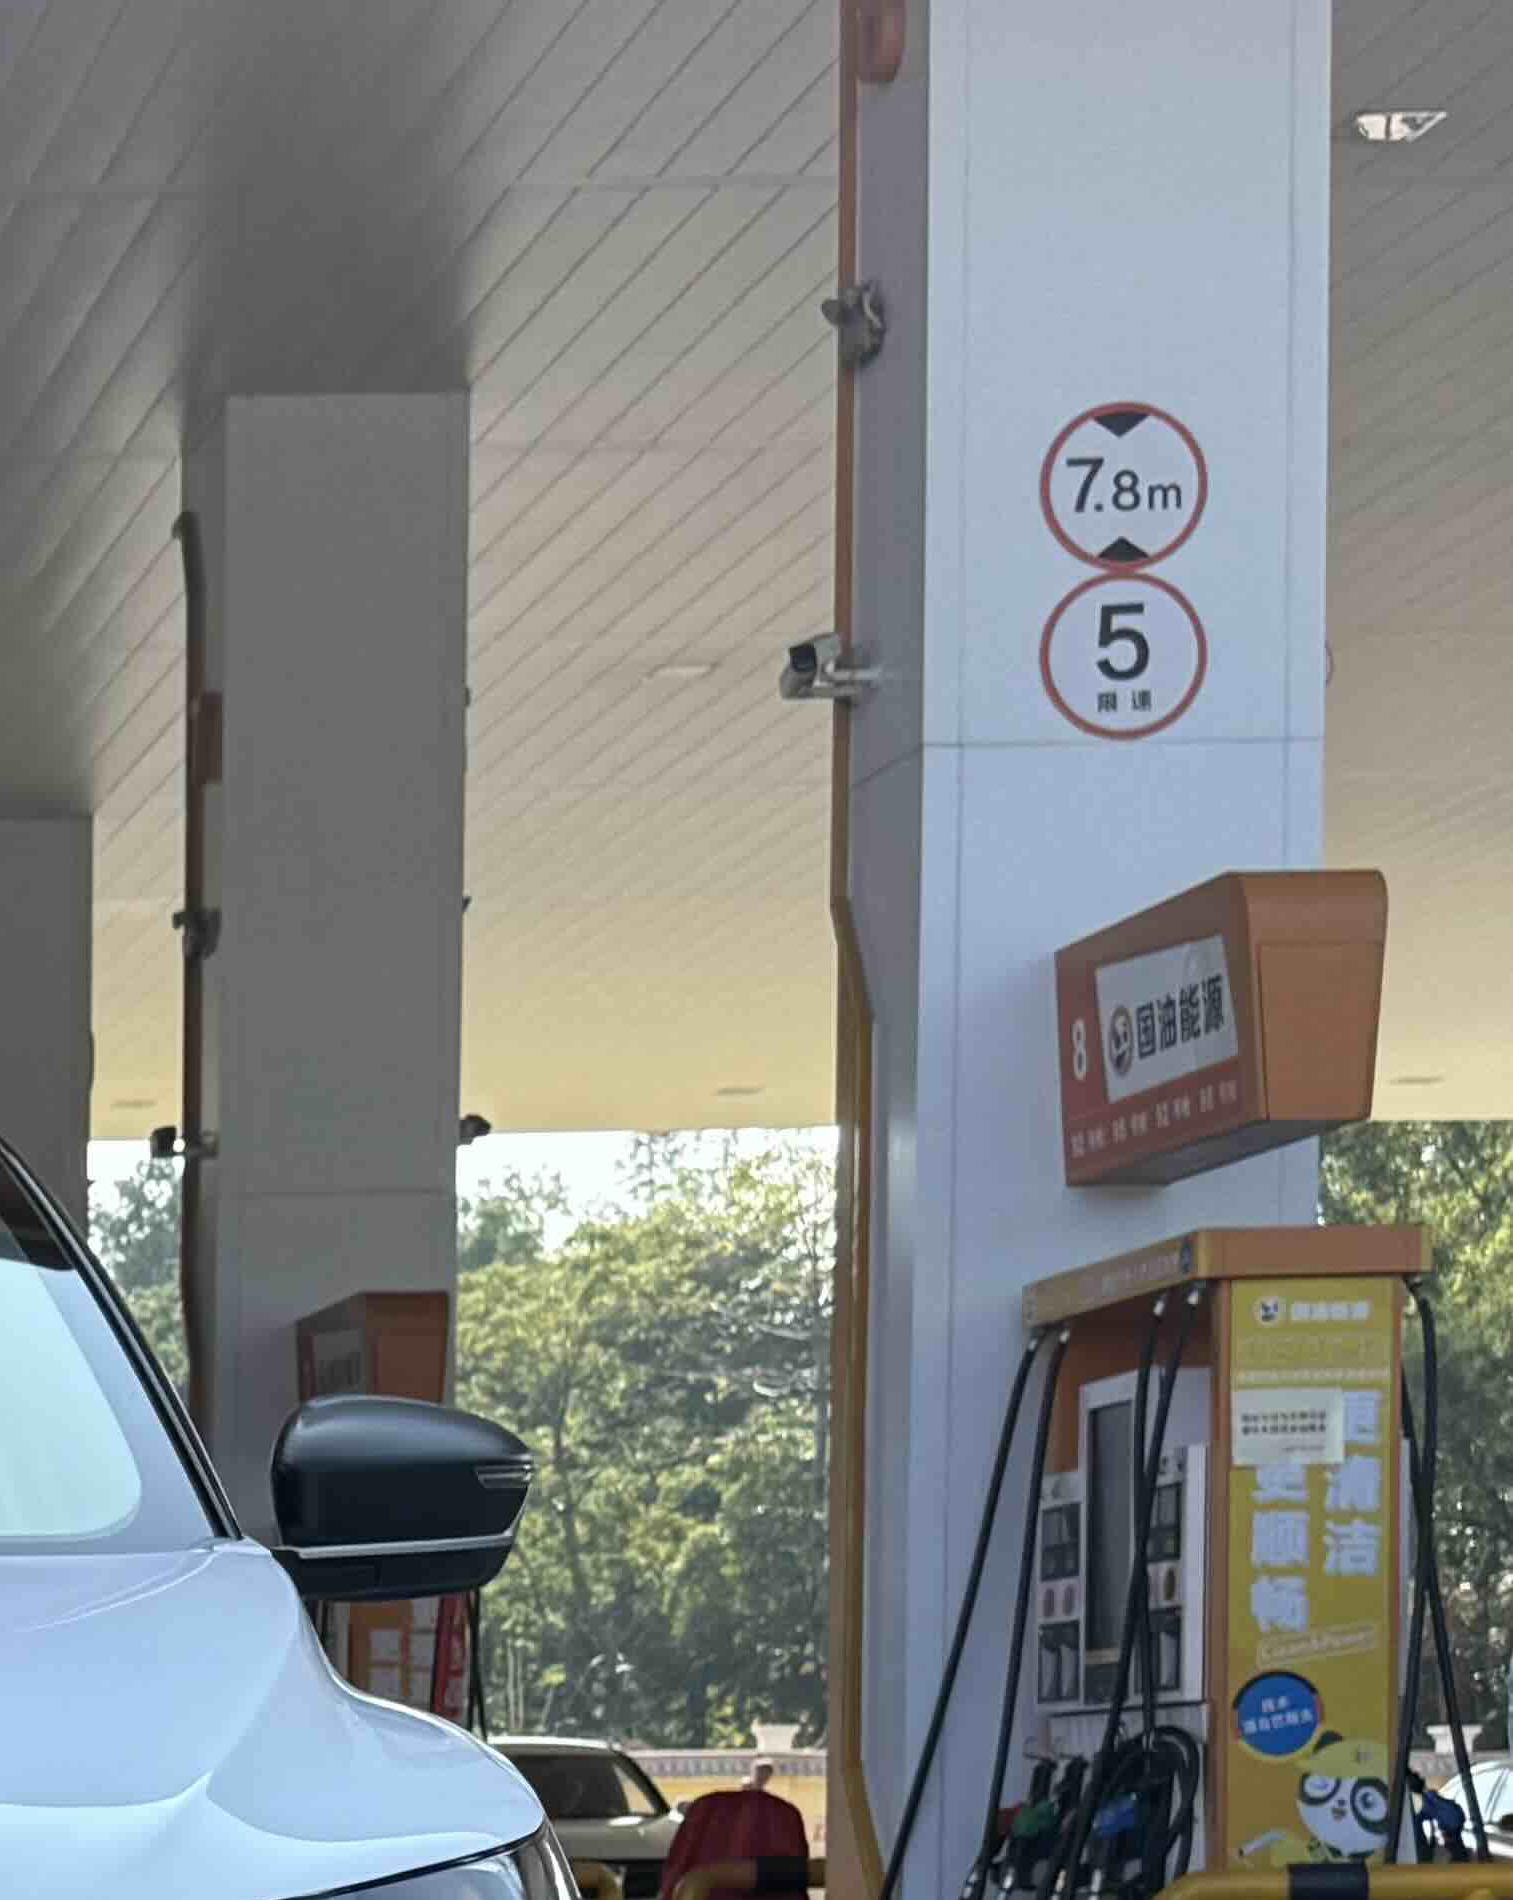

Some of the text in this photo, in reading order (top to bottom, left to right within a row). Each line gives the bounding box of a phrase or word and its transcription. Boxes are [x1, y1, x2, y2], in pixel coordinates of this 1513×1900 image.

[1065, 457, 1183, 514] 7.8m
[1096, 602, 1151, 682] 5
[1097, 690, 1152, 713] 限速
[1135, 973, 1225, 1060] 国油能源
[1071, 1018, 1088, 1082] 8
